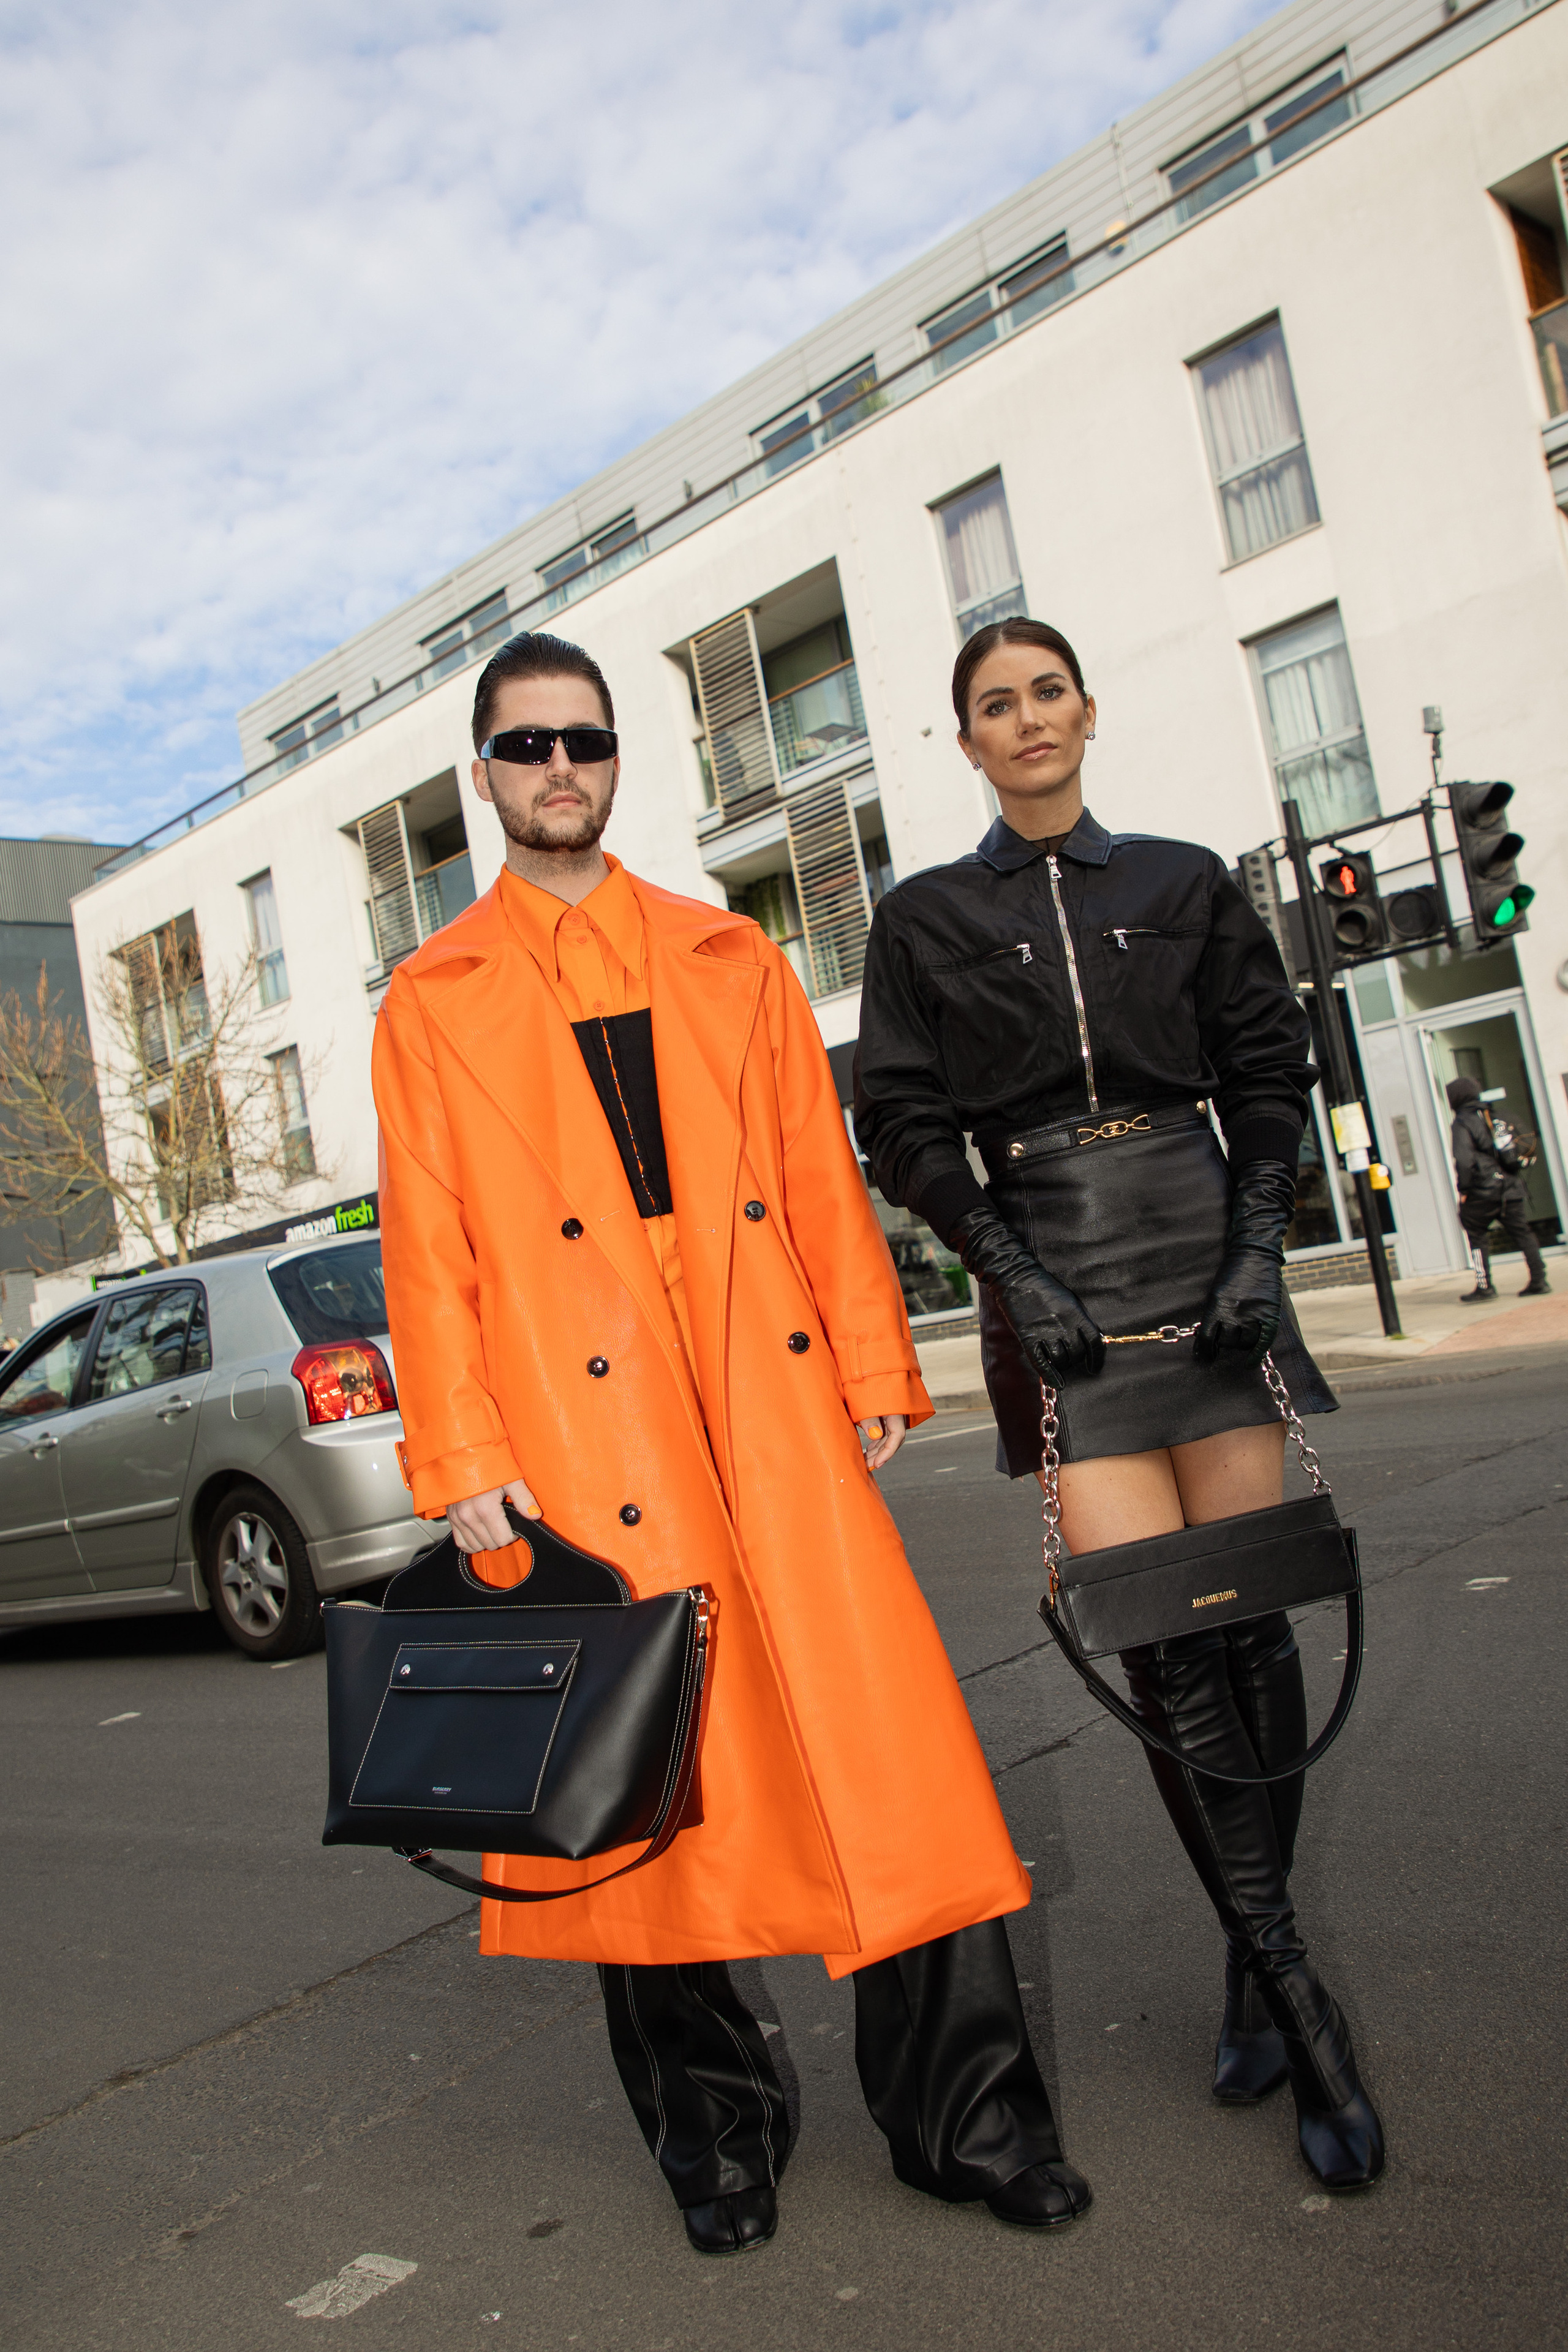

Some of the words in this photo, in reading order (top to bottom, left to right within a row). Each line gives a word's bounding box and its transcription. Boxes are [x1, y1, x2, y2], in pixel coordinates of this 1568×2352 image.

[285, 1215, 337, 1243] amazon
[335, 1199, 374, 1232] fresh
[1192, 1589, 1238, 1608] JACQUEMUS
